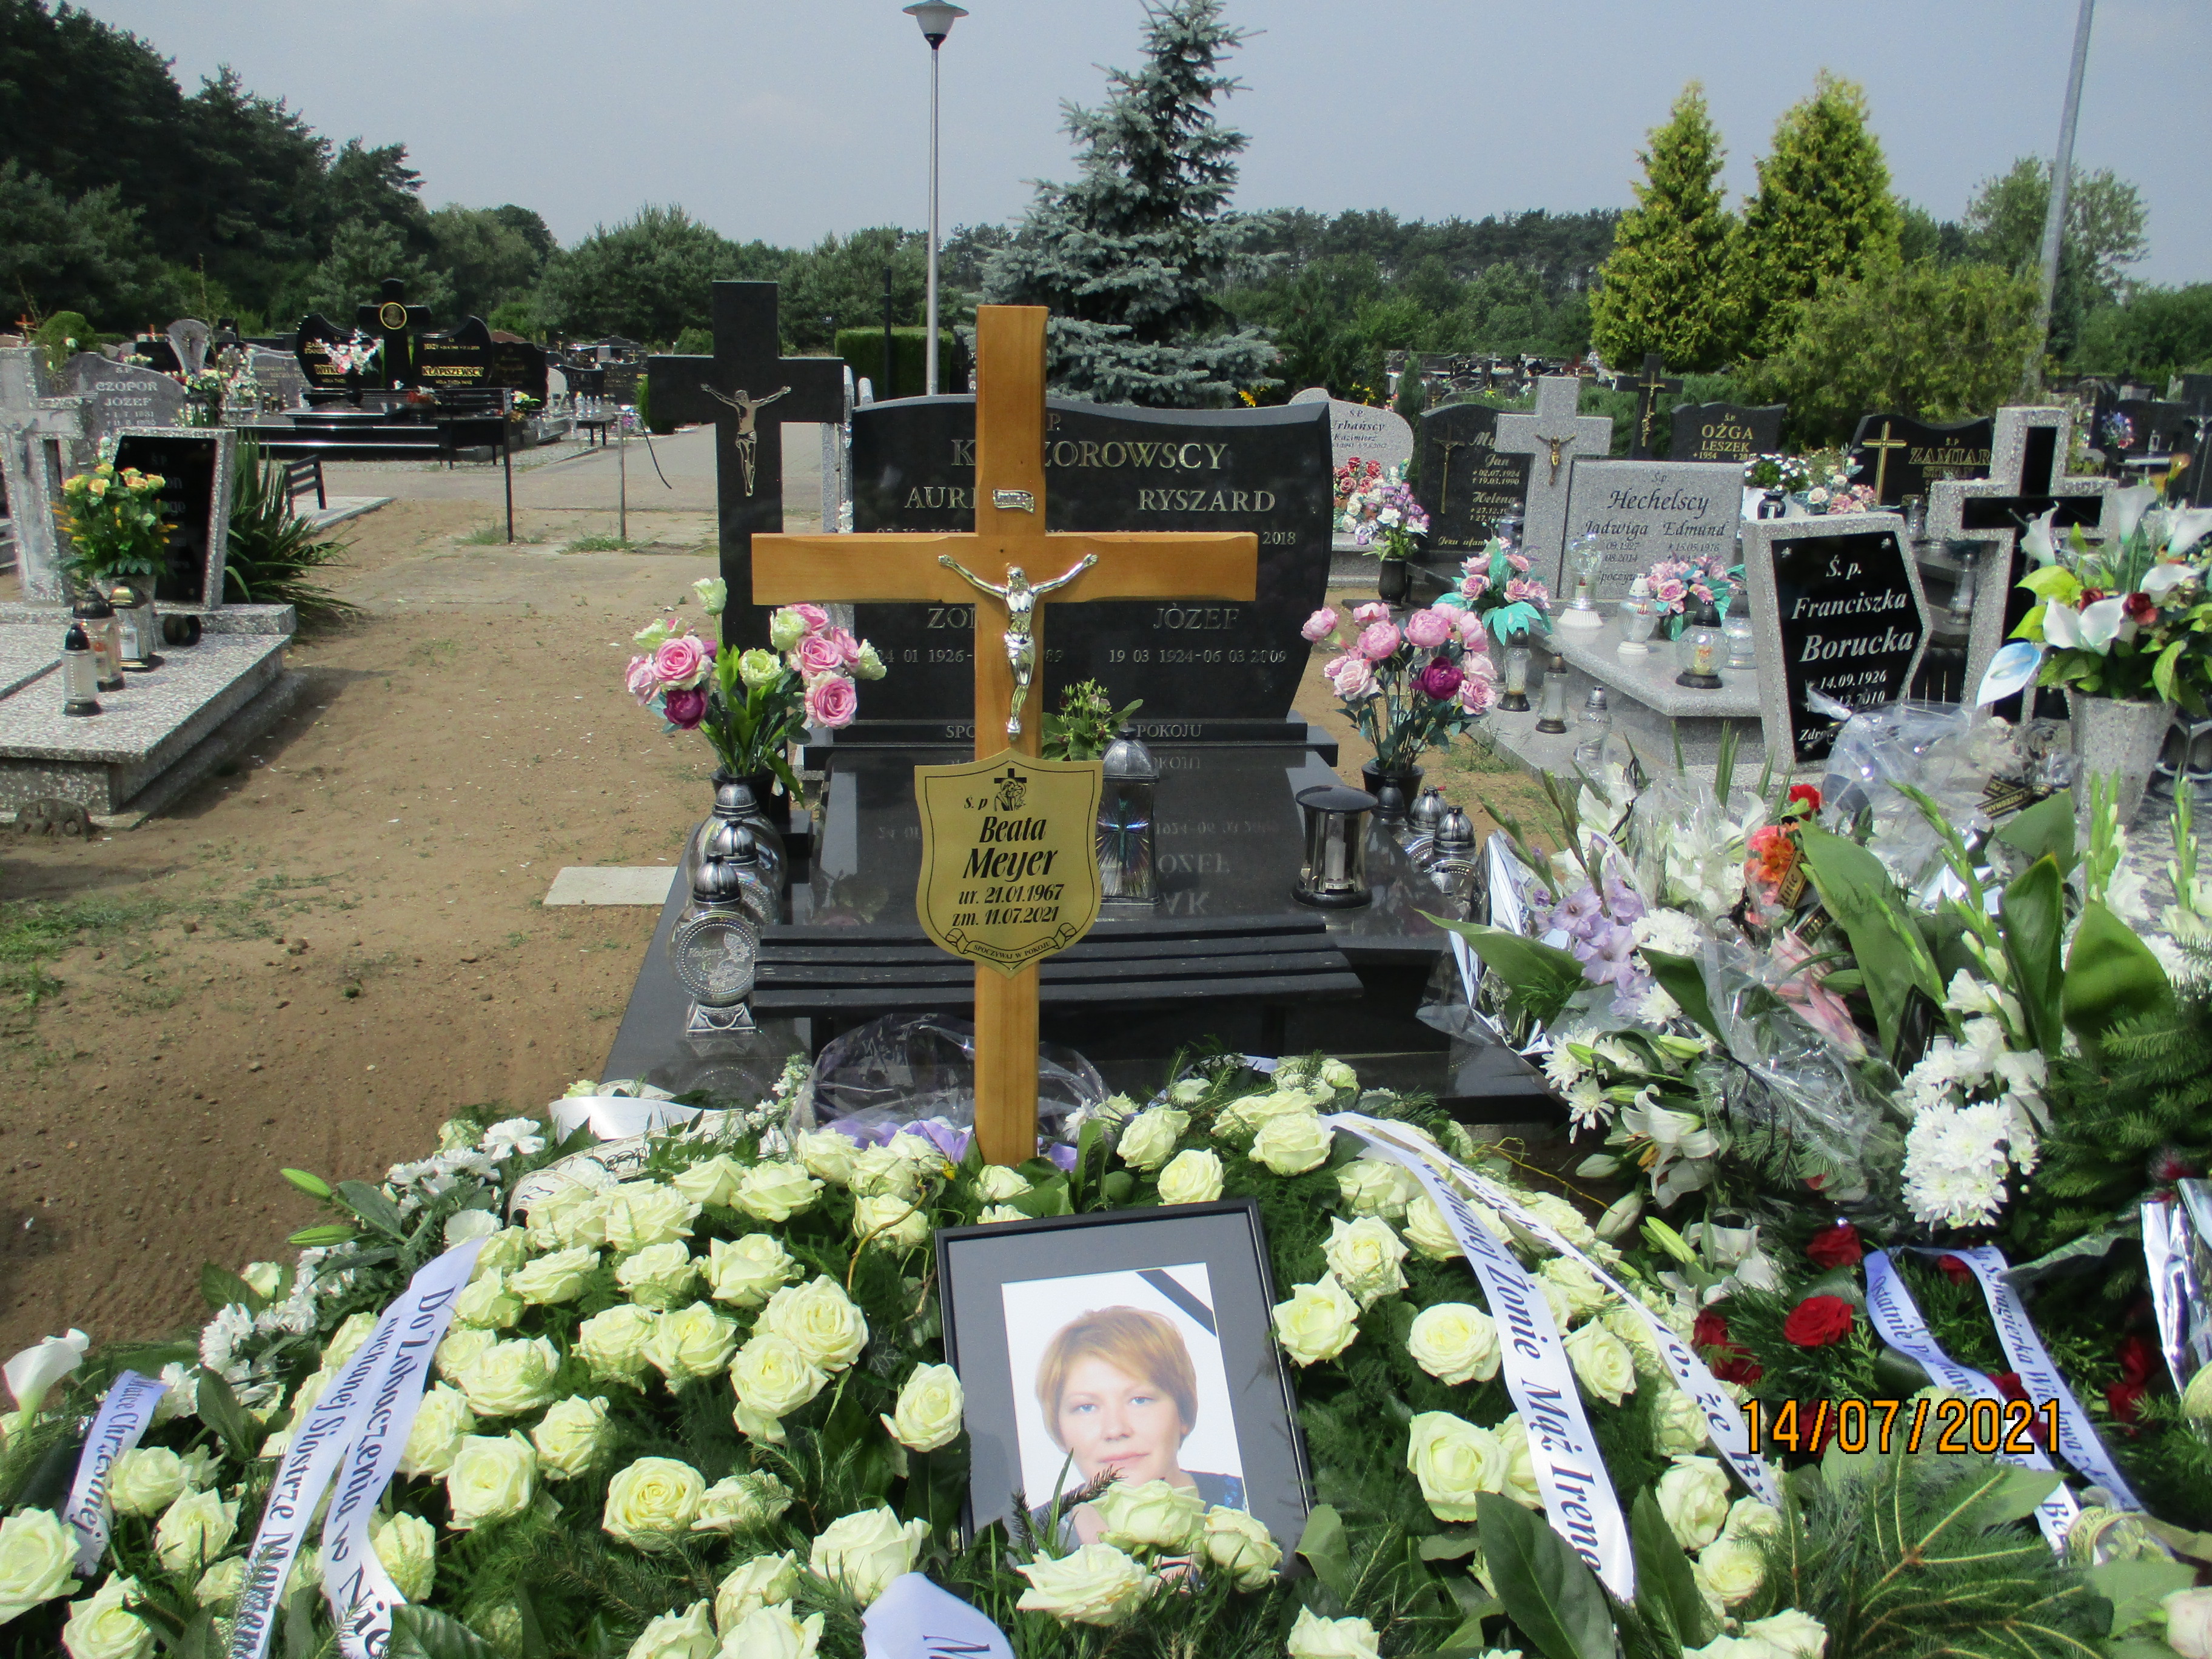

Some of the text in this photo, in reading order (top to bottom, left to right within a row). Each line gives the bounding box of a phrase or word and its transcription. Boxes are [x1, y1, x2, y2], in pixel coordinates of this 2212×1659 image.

[1701, 423, 1754, 440] OŻGA
[1701, 440, 1751, 452] LESZEK
[1485, 454, 1509, 468] Jan
[1138, 489, 1276, 512] RYSZARD
[1607, 488, 1710, 519] Hechelscy
[1262, 531, 1296, 545] 2018
[1581, 518, 1729, 540] Jadwiga Edmund
[1791, 588, 1907, 619] Franciszka
[1153, 603, 1240, 630] JÓZEF
[1798, 626, 1914, 662] Borucka
[1820, 669, 1887, 690] 14.09.1926
[1136, 725, 1202, 738] POKOJU
[979, 816, 1047, 843] Beata
[962, 847, 1058, 882] Meyer
[959, 883, 1064, 905] ur. 21.01.1967
[953, 906, 1059, 926] zm. 11.07.2021
[973, 944, 1013, 959] SPOCZYWAJ
[1024, 941, 1051, 956] POKOJU
[409, 1283, 458, 1330] Do
[1871, 1275, 1915, 1340] Ostatnie
[1485, 1262, 1548, 1359] Żonie
[1521, 1376, 1583, 1456] Mąż
[335, 1329, 437, 1523] Zobaczenia
[269, 1416, 347, 1520] Siostrze
